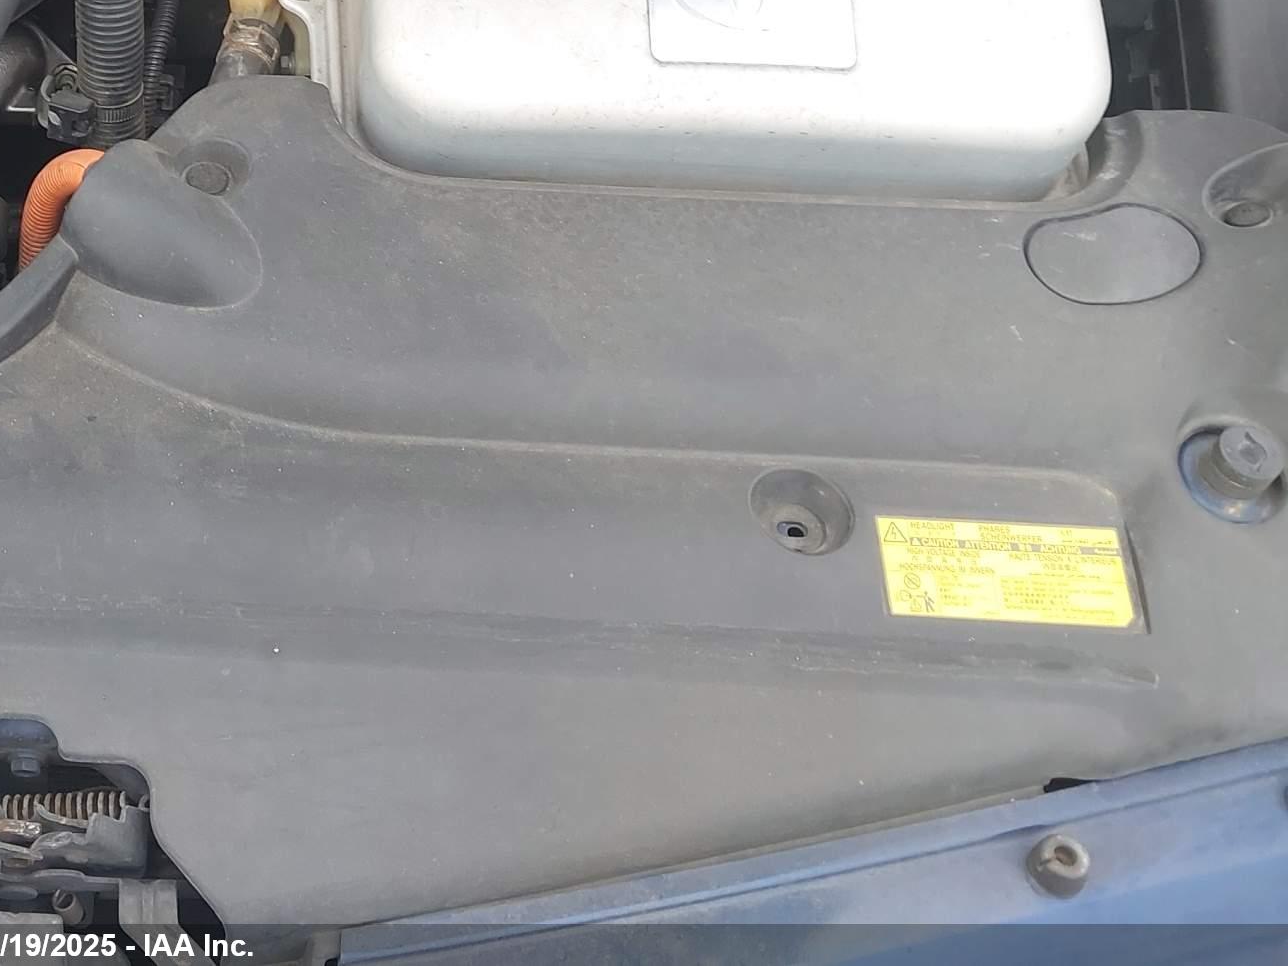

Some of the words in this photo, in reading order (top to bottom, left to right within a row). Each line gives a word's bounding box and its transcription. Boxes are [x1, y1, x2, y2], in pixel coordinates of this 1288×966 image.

[910, 521, 955, 530] HEADLIGHT
[921, 537, 959, 547] CAUTION
[964, 539, 1012, 551] ATTENTION
[1040, 543, 1081, 554] ACHTUNG
